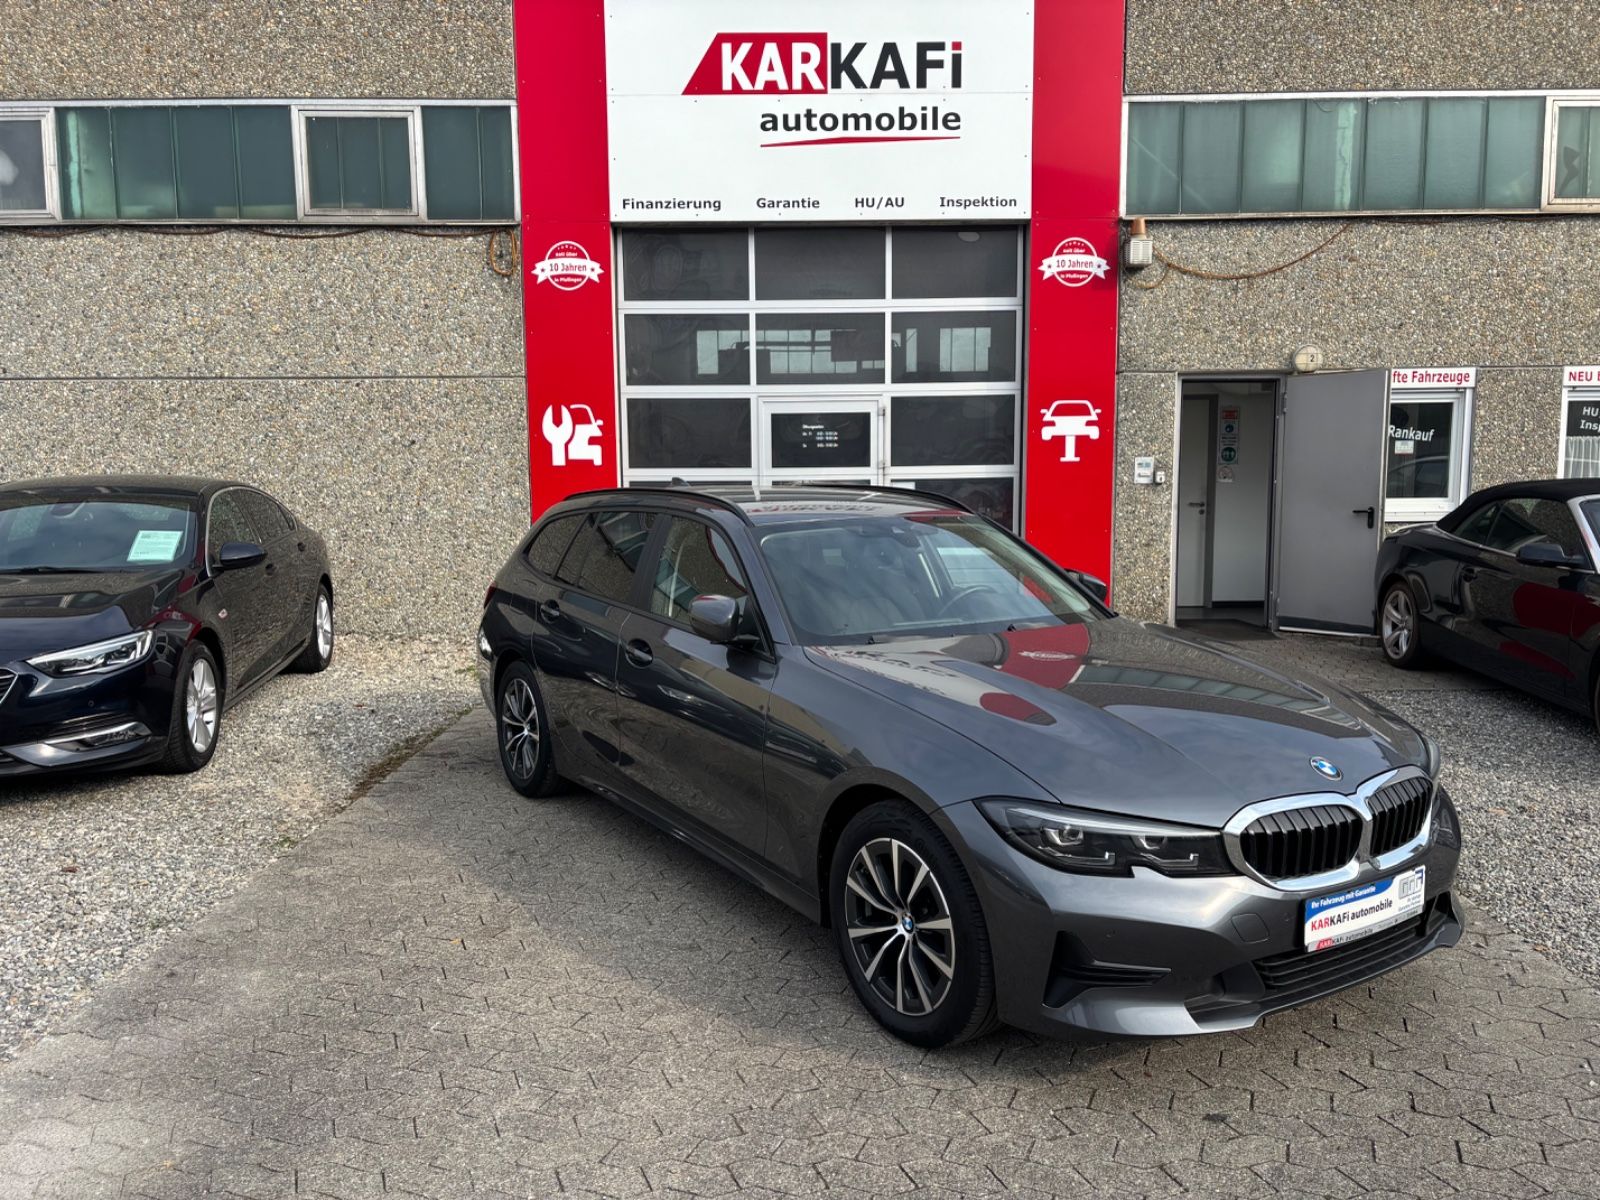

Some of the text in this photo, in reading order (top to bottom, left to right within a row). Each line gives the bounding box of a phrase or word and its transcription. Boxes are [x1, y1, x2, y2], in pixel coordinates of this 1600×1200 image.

[720, 41, 963, 91] KARKAFi
[759, 105, 962, 132] automobile
[622, 198, 722, 212] Finanzierung
[756, 197, 820, 209] Garantie
[854, 196, 905, 210] HU/AU
[939, 196, 1018, 210] Inspektion
[549, 262, 587, 272] 10 Jahren
[1056, 258, 1094, 269] 10 Jahren
[1310, 354, 1315, 363] 2
[1411, 370, 1470, 385] Fahrzeuge
[1568, 371, 1593, 382] NEU
[1582, 405, 1600, 418] HU
[1320, 895, 1345, 907] Fahrzeug
[1310, 911, 1350, 932] KARKAFi
[1350, 898, 1393, 919] automobile
